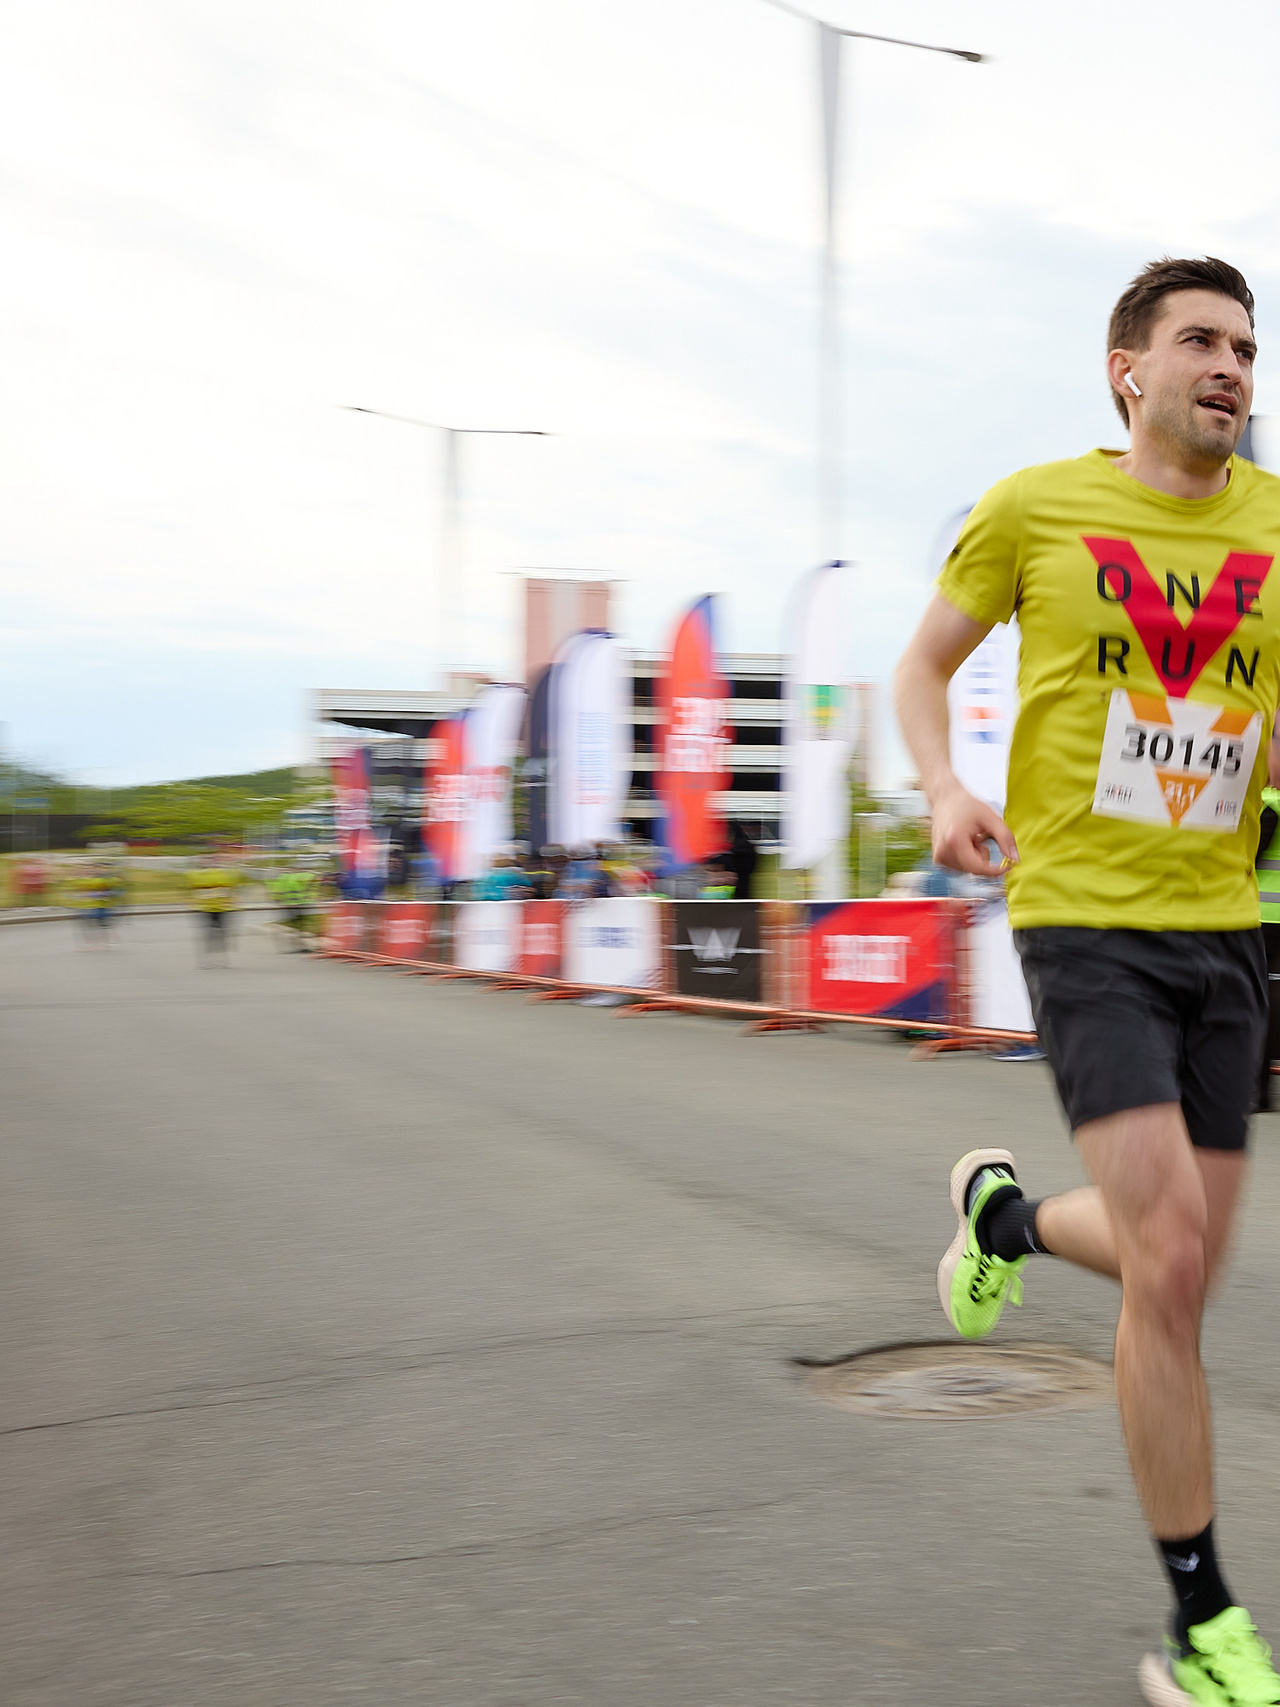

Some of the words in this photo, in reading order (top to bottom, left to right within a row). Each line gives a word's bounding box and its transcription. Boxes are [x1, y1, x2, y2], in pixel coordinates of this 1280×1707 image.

[1096, 560, 1264, 620] ONE
[1097, 630, 1260, 690] RUN
[1119, 722, 1244, 777] 30145
